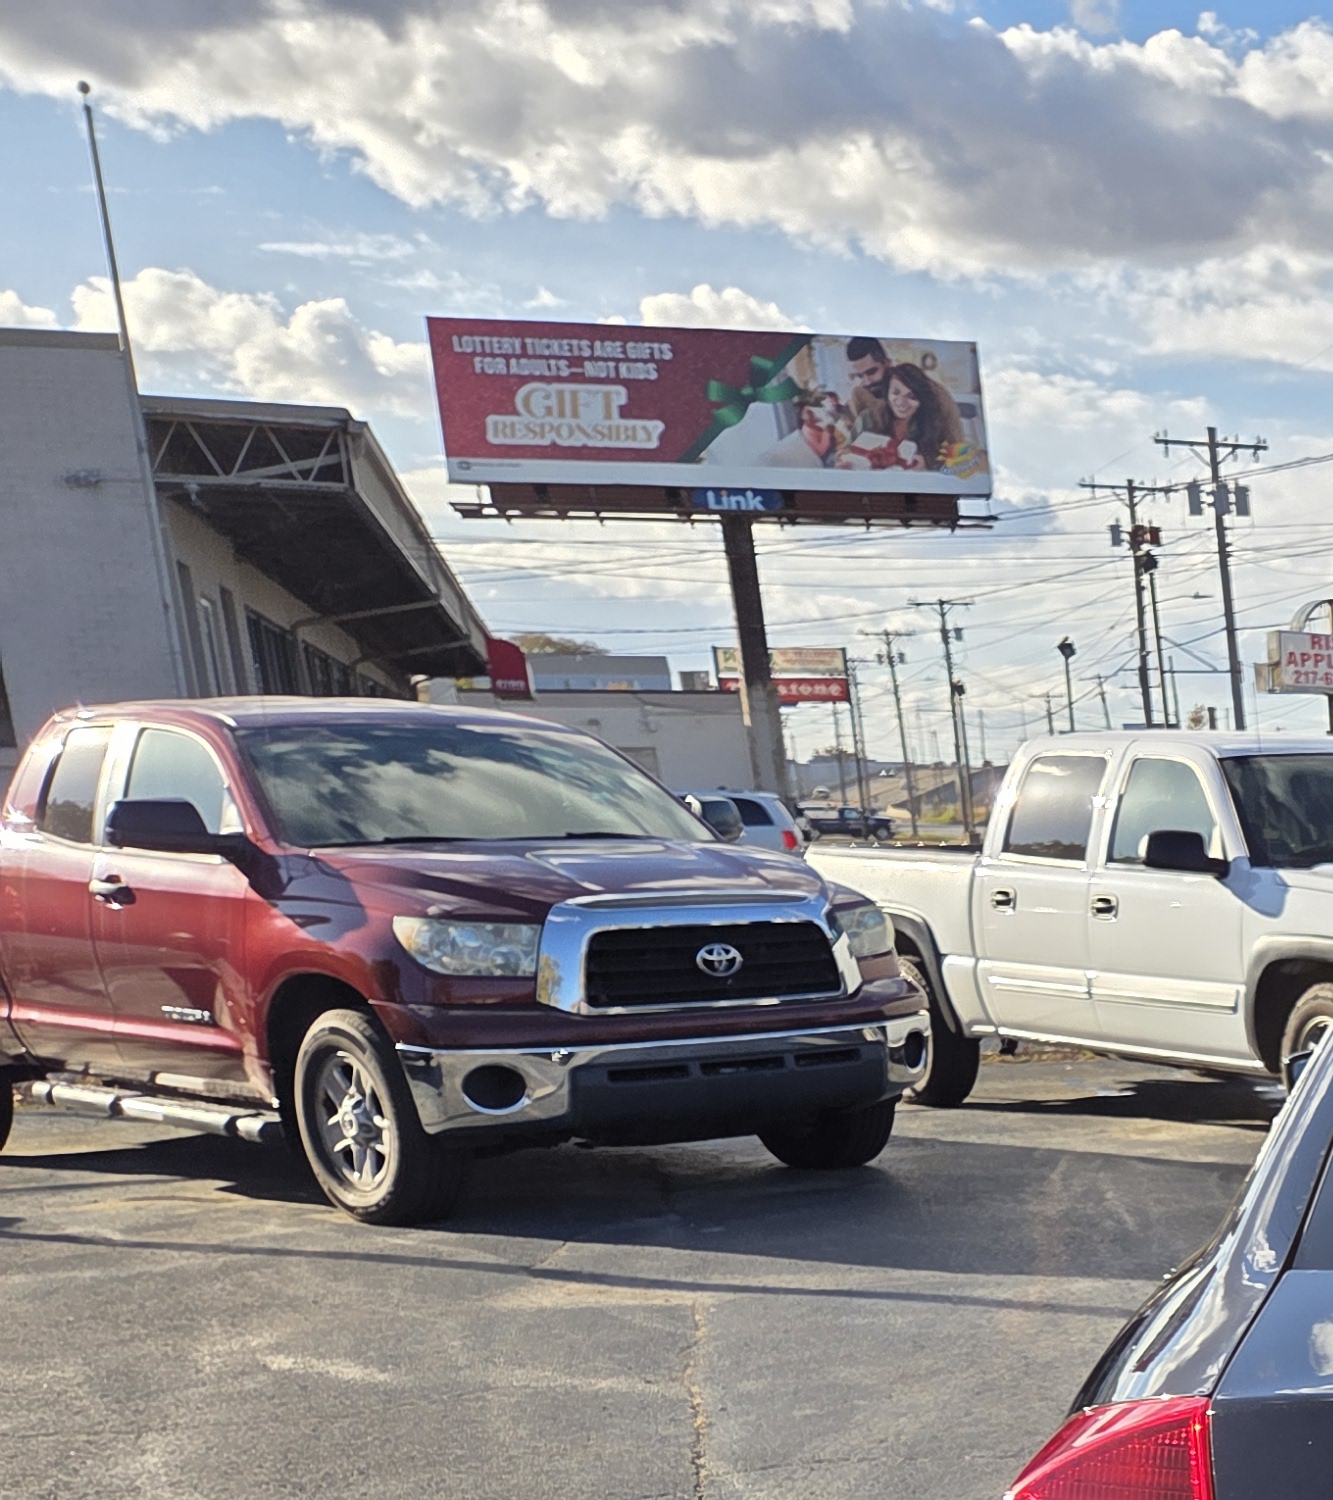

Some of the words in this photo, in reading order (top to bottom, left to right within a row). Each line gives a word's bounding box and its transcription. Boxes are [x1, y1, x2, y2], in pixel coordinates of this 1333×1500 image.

[452, 335, 521, 354] LOTTERY
[524, 337, 591, 357] TICKETS
[593, 340, 626, 358] ARE
[626, 342, 673, 360] GIFTS
[474, 357, 507, 375] FOR
[619, 362, 658, 380] KIDS
[522, 387, 622, 420] GIFT
[491, 419, 659, 443] RESPONSIBLY
[706, 489, 766, 511] Link
